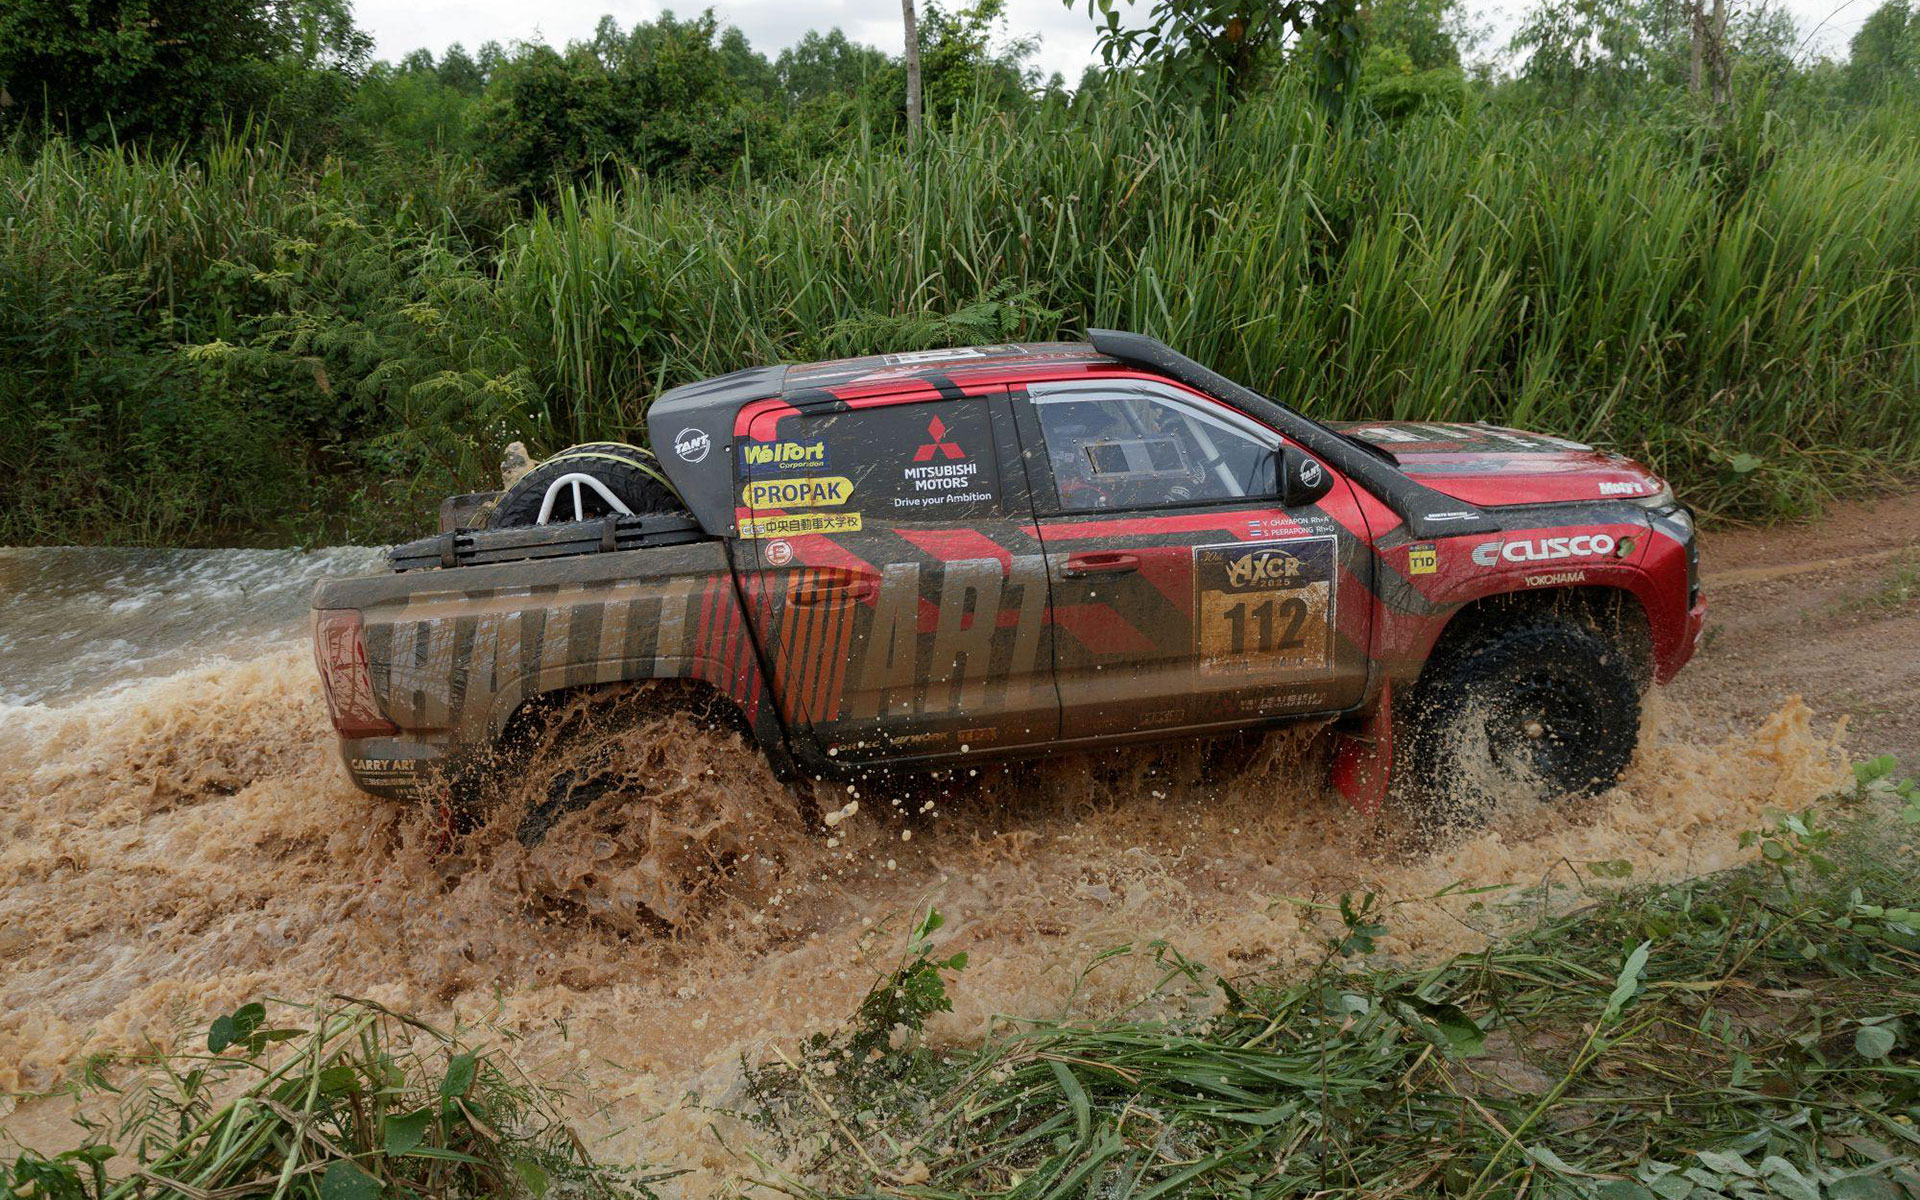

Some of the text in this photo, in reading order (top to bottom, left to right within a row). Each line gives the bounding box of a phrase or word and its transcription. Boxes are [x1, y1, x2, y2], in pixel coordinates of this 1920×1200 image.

[904, 463, 977, 479] MITSUBISHI
[915, 477, 969, 491] MOTORS
[753, 482, 842, 504] PROPAK
[894, 491, 992, 507] Drive your Ambition
[766, 516, 858, 533] 中央自動車大学校
[1502, 534, 1615, 562] CUSCO
[1226, 552, 1302, 587] AXCR
[1411, 557, 1434, 568] T1D
[1525, 571, 1585, 586] YOKOHAMA
[1223, 597, 1309, 654] 112
[352, 759, 416, 770] CARRY ART
